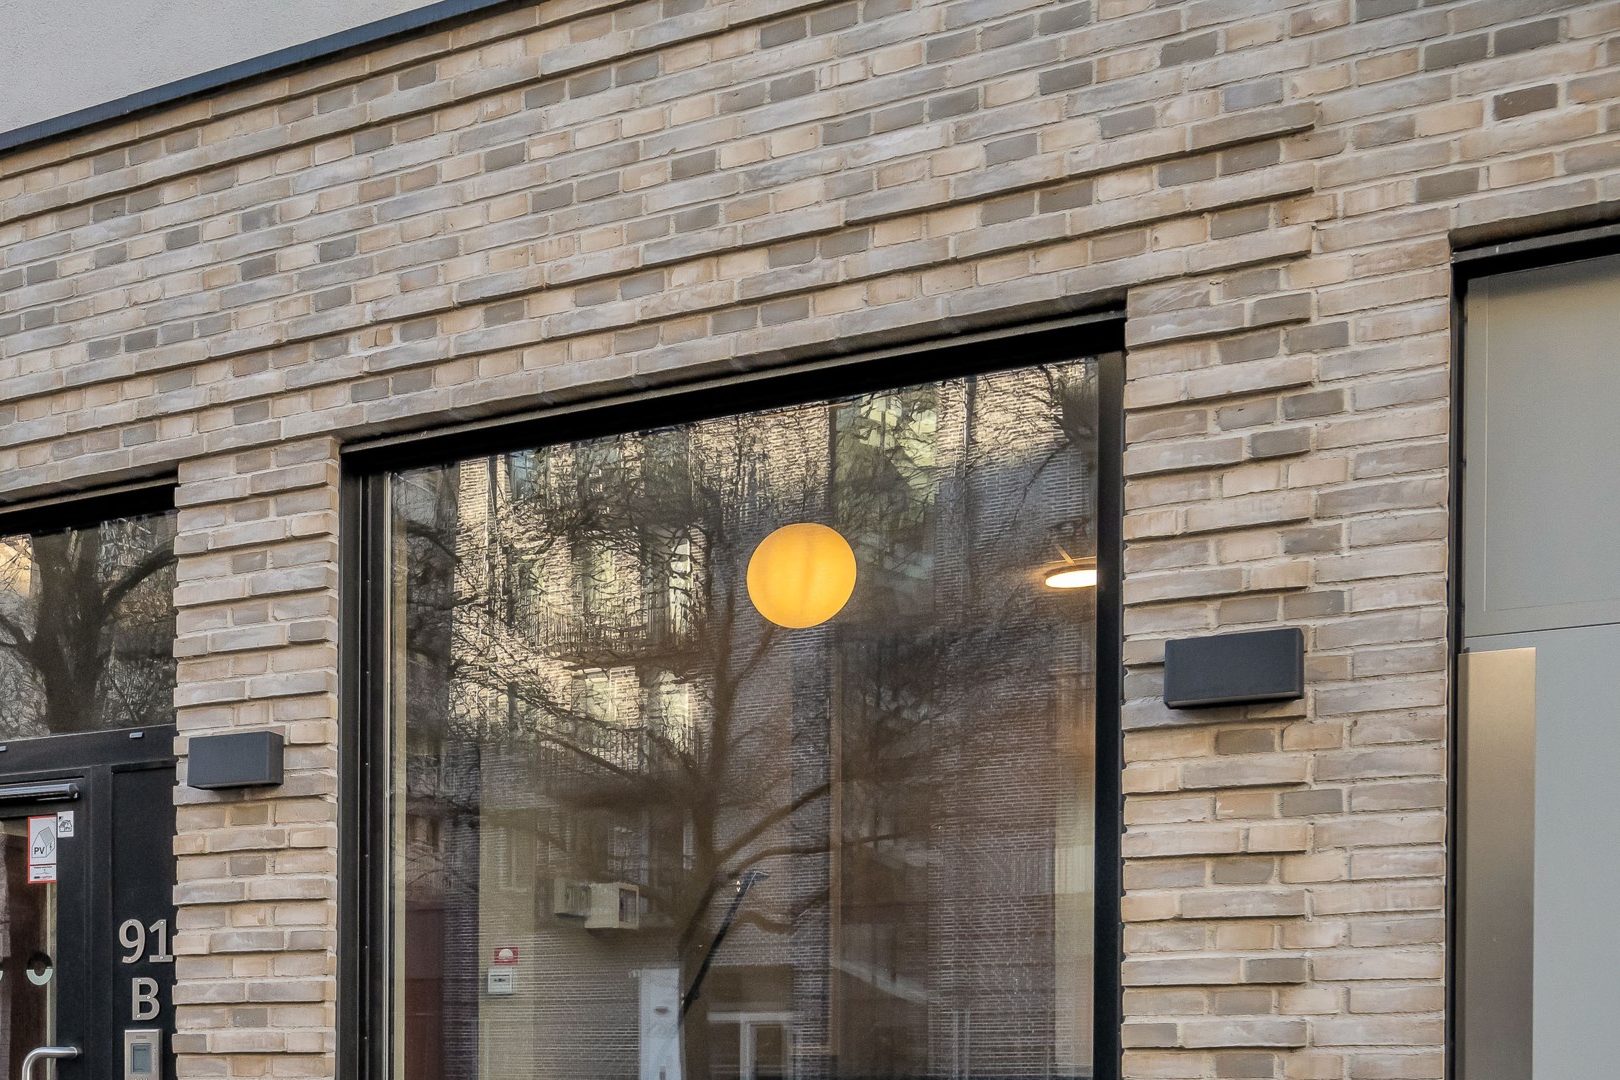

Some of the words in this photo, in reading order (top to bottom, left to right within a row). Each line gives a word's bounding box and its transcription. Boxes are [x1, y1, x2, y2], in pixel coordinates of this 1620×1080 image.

[33, 846, 45, 854] PV
[118, 918, 173, 963] 91
[132, 977, 160, 1021] B
